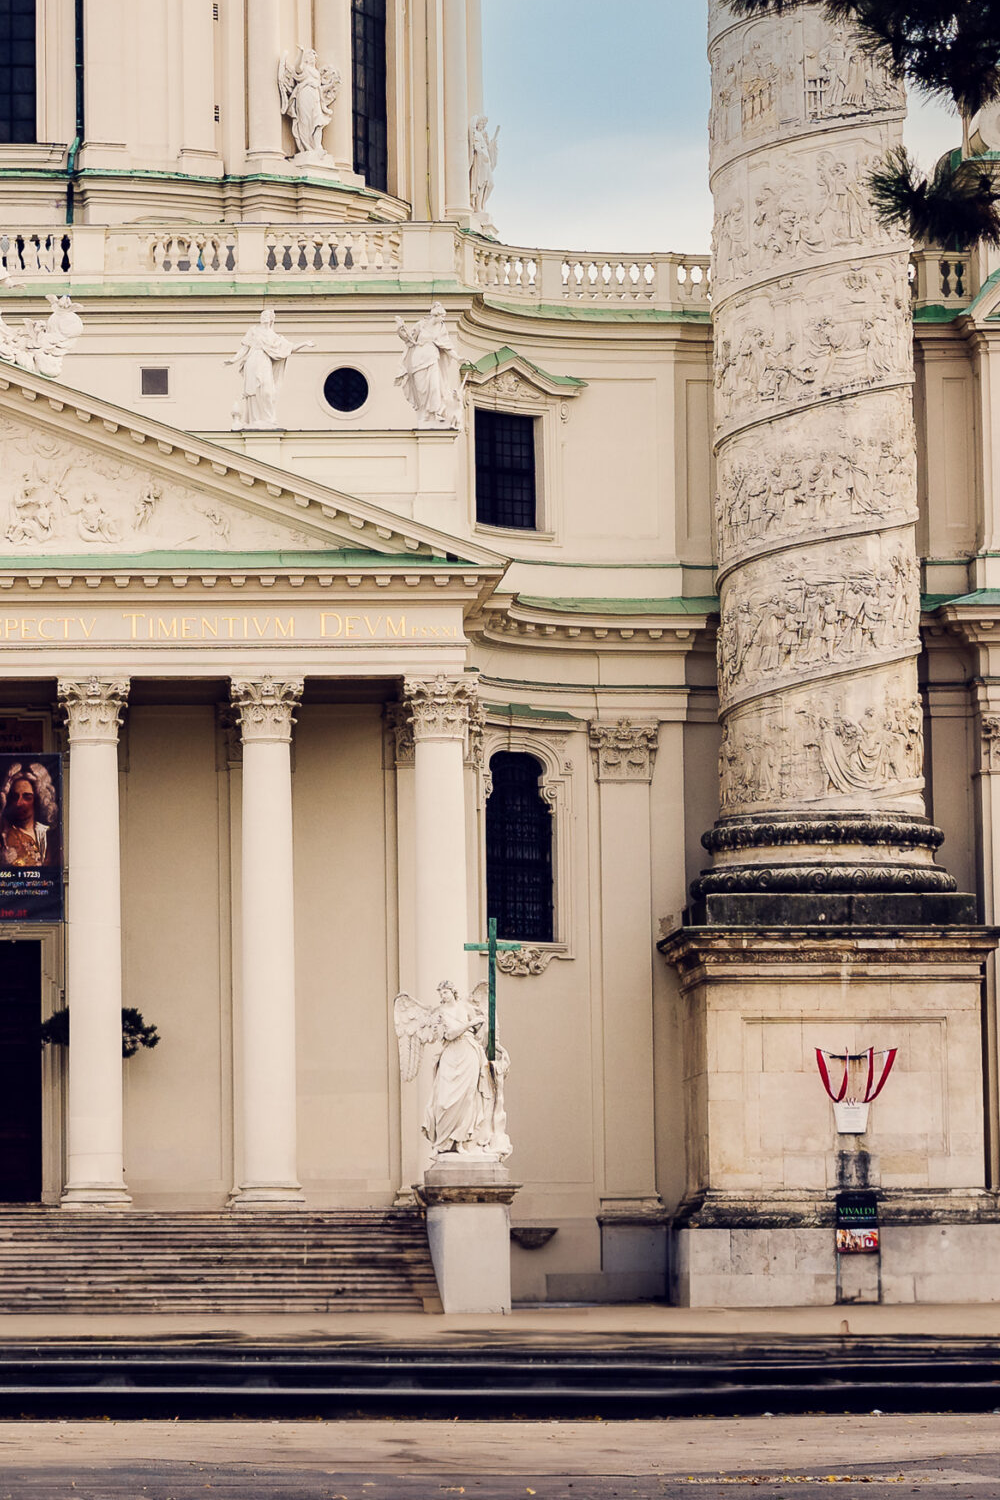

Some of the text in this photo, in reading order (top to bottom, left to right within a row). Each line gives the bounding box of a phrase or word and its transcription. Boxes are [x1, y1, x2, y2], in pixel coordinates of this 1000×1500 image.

[122, 613, 295, 639] TIMENTIVM
[320, 612, 406, 638] DEVM
[23, 871, 41, 879] 1723)
[839, 1207, 875, 1215] VIVALDI
